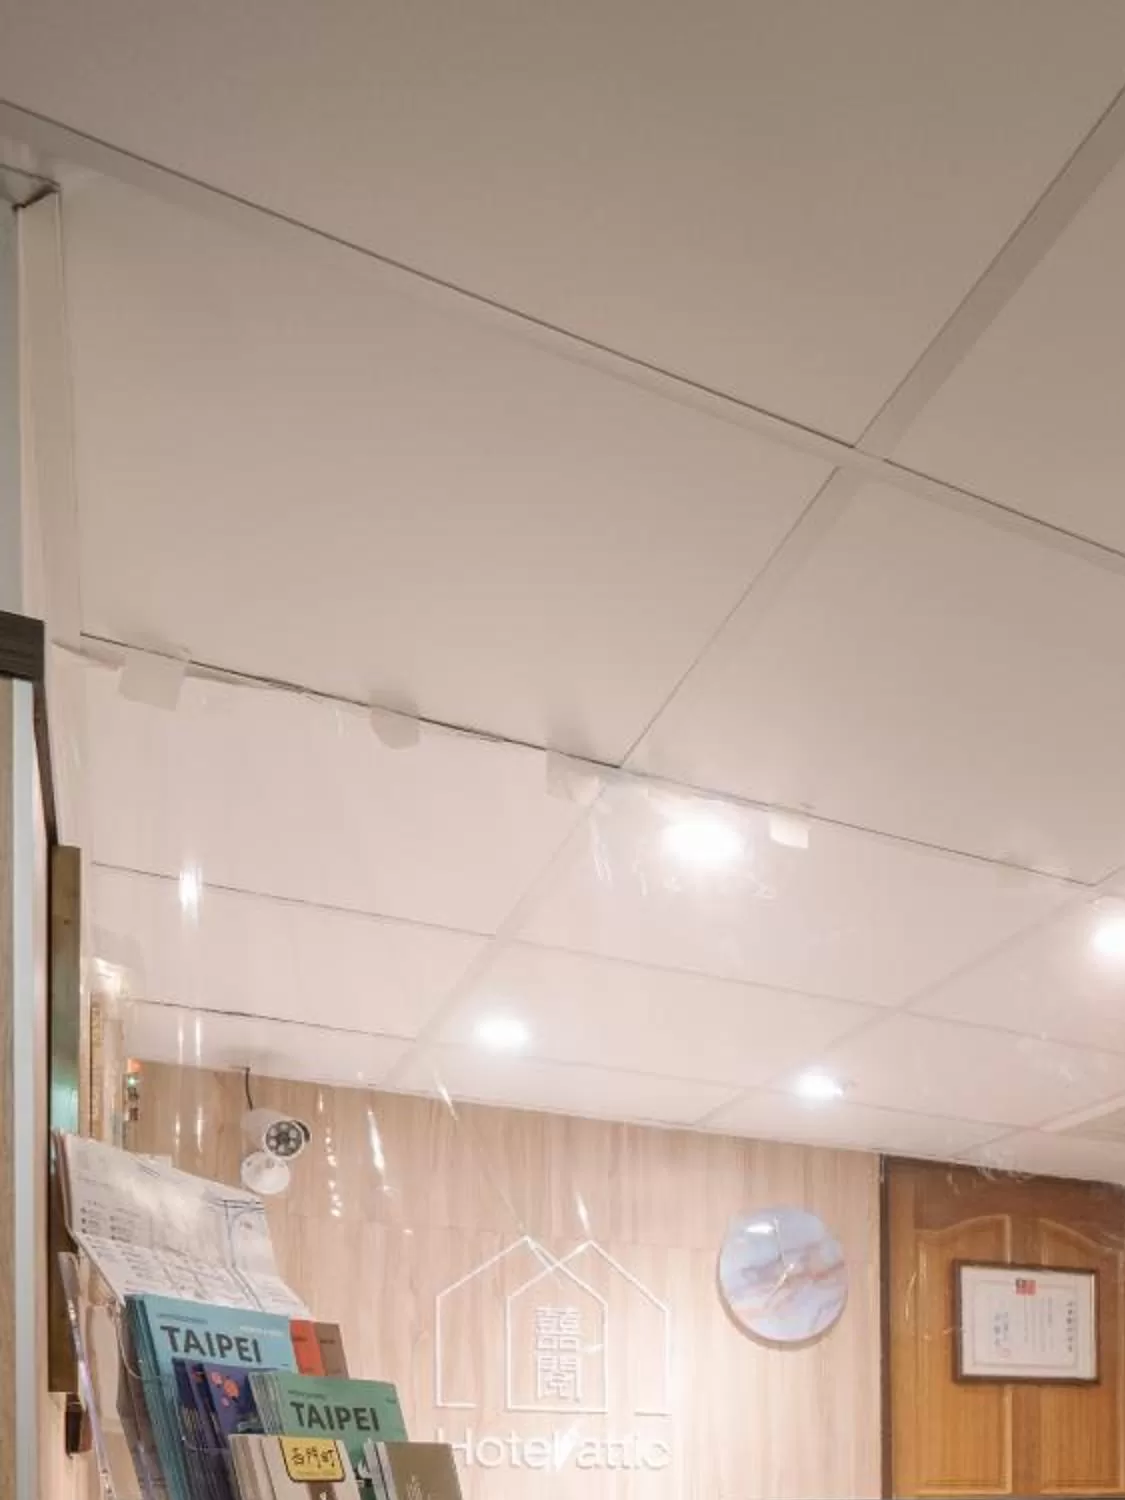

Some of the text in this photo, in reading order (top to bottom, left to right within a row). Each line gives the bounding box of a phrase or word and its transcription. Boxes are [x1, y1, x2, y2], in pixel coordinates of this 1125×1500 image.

[160, 1325, 262, 1363] TAIPEI
[289, 1401, 380, 1432] TAIPEI
[433, 1427, 672, 1471] Hotel attic
